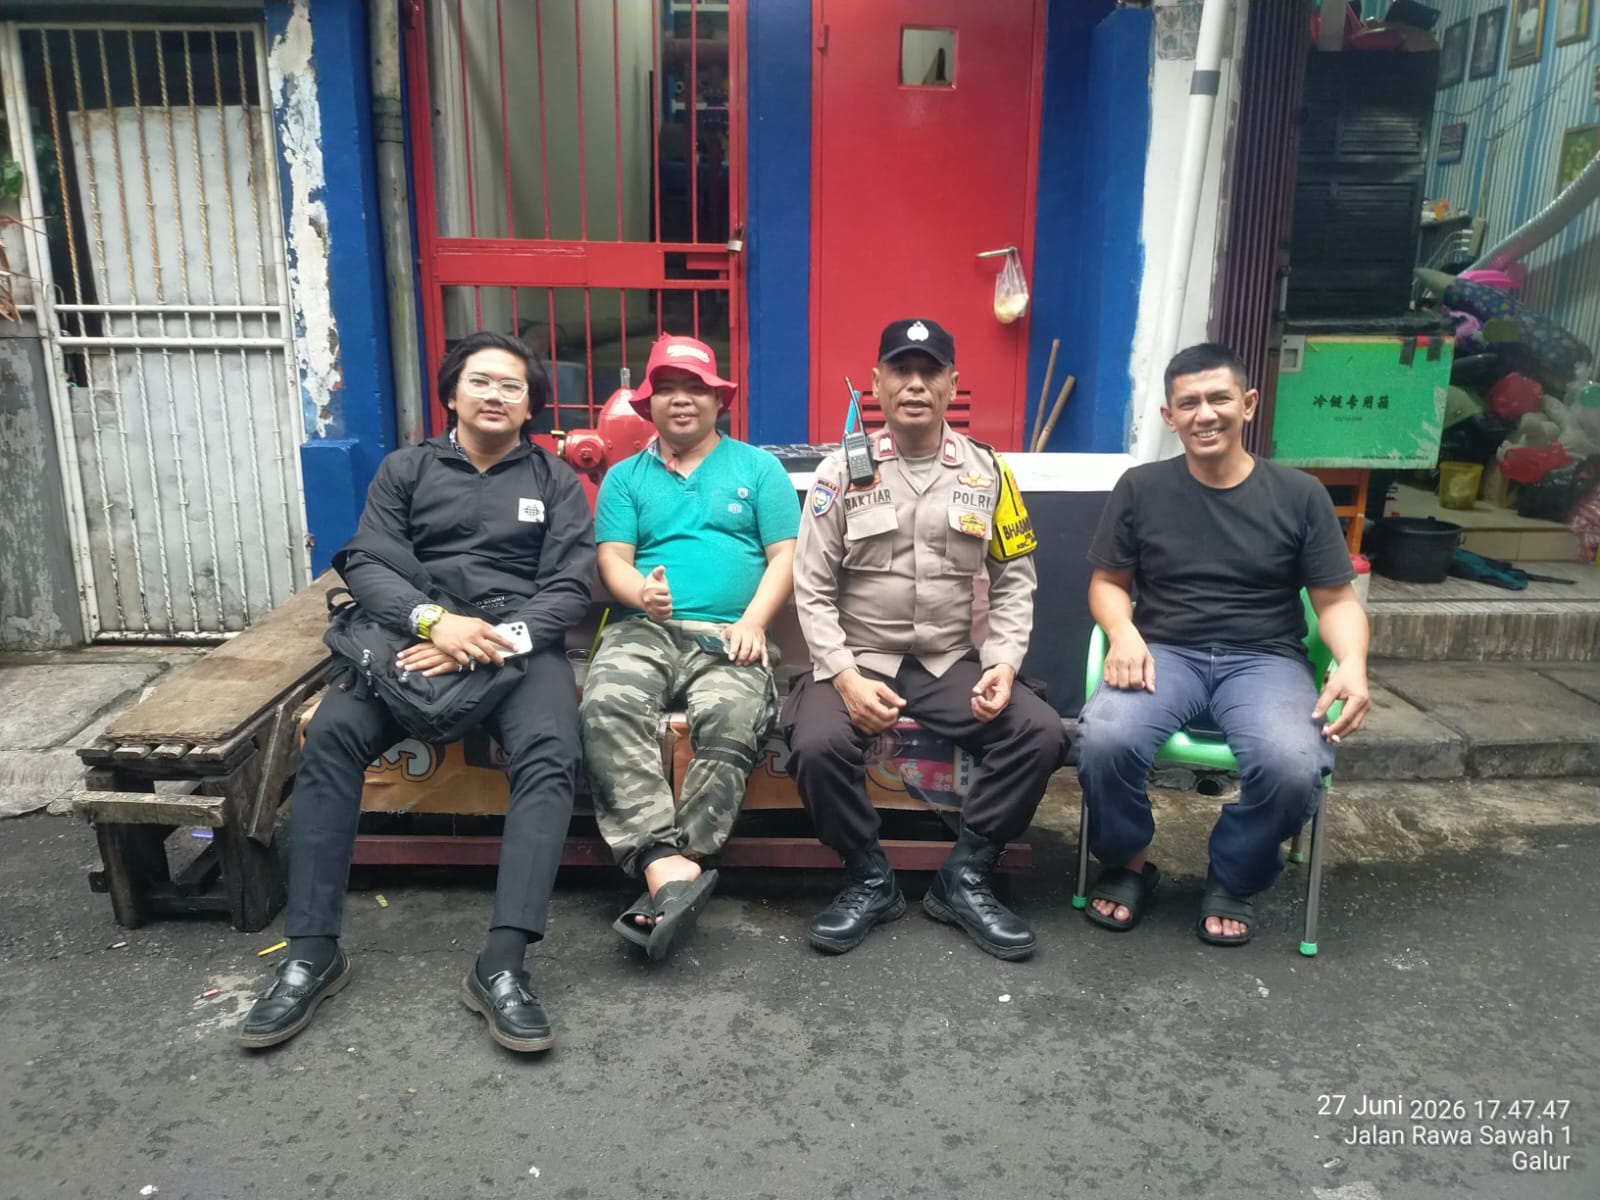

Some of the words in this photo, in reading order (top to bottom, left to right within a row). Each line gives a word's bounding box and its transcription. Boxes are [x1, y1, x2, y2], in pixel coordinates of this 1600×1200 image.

[1312, 393, 1389, 410] 冷链专用箱
[845, 488, 892, 510] BAKTIAR
[952, 490, 992, 510] POLRI
